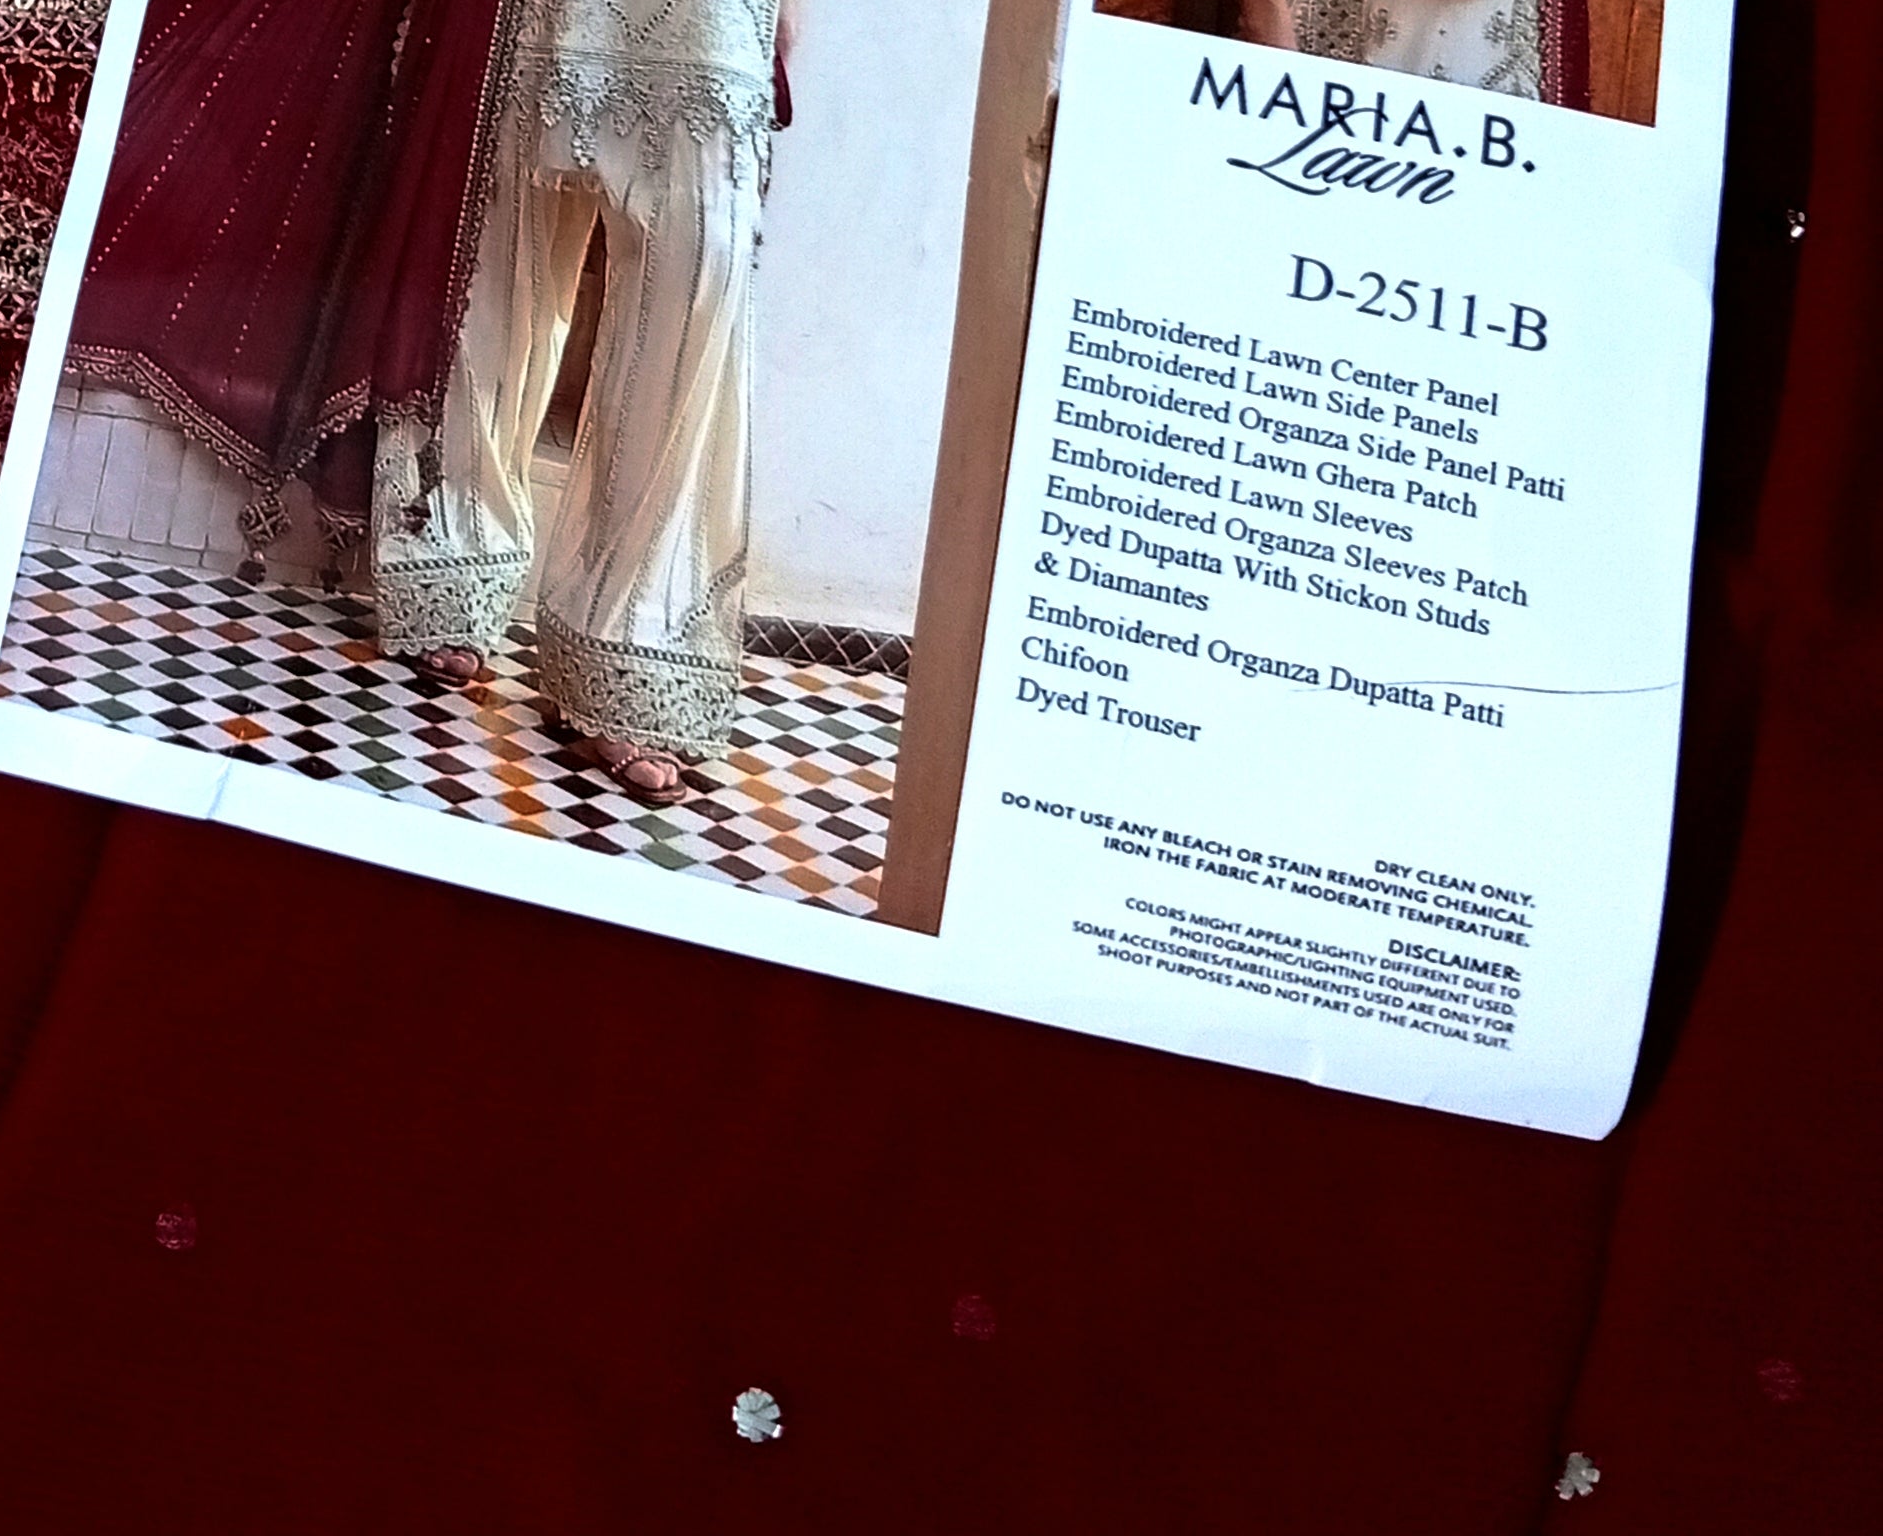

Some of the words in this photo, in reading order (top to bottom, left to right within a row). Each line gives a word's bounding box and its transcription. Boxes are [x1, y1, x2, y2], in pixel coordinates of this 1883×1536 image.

[1189, 56, 1536, 173] MARIA.B.
[1226, 106, 1454, 205] Lawn
[1286, 253, 1548, 352] D-2511-B
[1065, 330, 1237, 390] Embroidered
[1243, 370, 1318, 410] Lawn
[1326, 390, 1385, 423] Side
[1392, 404, 1479, 445] Panels
[1071, 298, 1241, 358] Embroidered
[1248, 337, 1322, 377] Lawn
[1330, 358, 1420, 398] Center
[1425, 377, 1499, 417] Panel
[1053, 399, 1226, 460] Embroidered
[1232, 440, 1307, 480] Lawn
[1315, 461, 1396, 500] Ghera
[1403, 479, 1478, 519] Patch
[1060, 364, 1231, 425] Embroidered
[1238, 406, 1350, 452] Organza
[1357, 432, 1417, 467] Side
[1424, 446, 1498, 486] Panel
[1505, 465, 1566, 502] Patti
[1045, 473, 1217, 536] Embroidered
[1224, 517, 1336, 564] Organza
[1344, 543, 1446, 588] Sleeves
[1453, 567, 1529, 608] Patch
[1051, 437, 1222, 499] Embroidered
[1228, 479, 1304, 519] Lawn
[1312, 499, 1413, 543] Sleeves
[1033, 551, 1059, 577] &
[1067, 556, 1210, 612] Diamantes
[1040, 510, 1112, 549] Dyed
[1119, 528, 1223, 575] Dupatta
[1233, 554, 1298, 593] With
[1306, 573, 1408, 618] Stickon
[1415, 598, 1491, 636] Studs
[1015, 676, 1089, 716] Dyed
[1096, 695, 1202, 743] Trouser
[1020, 635, 1129, 683] Chifoon
[1026, 595, 1201, 658] Embroidered
[1207, 639, 1321, 686] Organza
[1326, 665, 1436, 712] Dupatta
[1442, 691, 1505, 728] Patti
[1001, 791, 1031, 810] DO
[1034, 799, 1077, 820] NOT
[1079, 810, 1115, 831] USE
[1117, 820, 1159, 840] ANY
[1161, 829, 1233, 858] BLEACH
[1236, 848, 1264, 866] OR
[1266, 854, 1323, 879] STAIN
[1326, 868, 1429, 904] REMOVING
[1103, 835, 1152, 859] IRON
[1155, 847, 1192, 869] THE
[1195, 857, 1260, 885] FABRIC
[1261, 874, 1287, 891] AT
[1290, 880, 1392, 916] MODERATE
[1374, 859, 1413, 879] DRY
[1415, 869, 1477, 895] CLEAN
[1072, 920, 1116, 941] SOME
[1118, 932, 1361, 999] ACCESSORIES/EMBELLISHMENTS
[1362, 989, 1405, 1009] USED
[1405, 1000, 1437, 1017] ARE
[1438, 1007, 1483, 1026] ONLY
[1483, 1017, 1516, 1034] FOR
[1097, 943, 1154, 967] SHOOT
[1155, 958, 1233, 987] PURPOSES
[1234, 978, 1272, 996] AND
[1274, 986, 1310, 1005] NOT
[1312, 995, 1351, 1014] PART
[1352, 1005, 1375, 1019] OF
[1378, 1010, 1408, 1028] THE
[1409, 1018, 1469, 1042] ACTUAL
[1125, 897, 1187, 922] COLORS
[1188, 912, 1243, 935] MIGHT
[1244, 926, 1303, 950] APPEAR
[1305, 940, 1378, 967] SLIGHTLY
[1379, 957, 1461, 986] DIFFERENT
[1462, 976, 1496, 995] DUE
[1499, 984, 1521, 1000] TO
[1169, 925, 1375, 985] PHOTOGRAPHIC/LIGHTING
[1378, 974, 1471, 1006] EQUIPMENT
